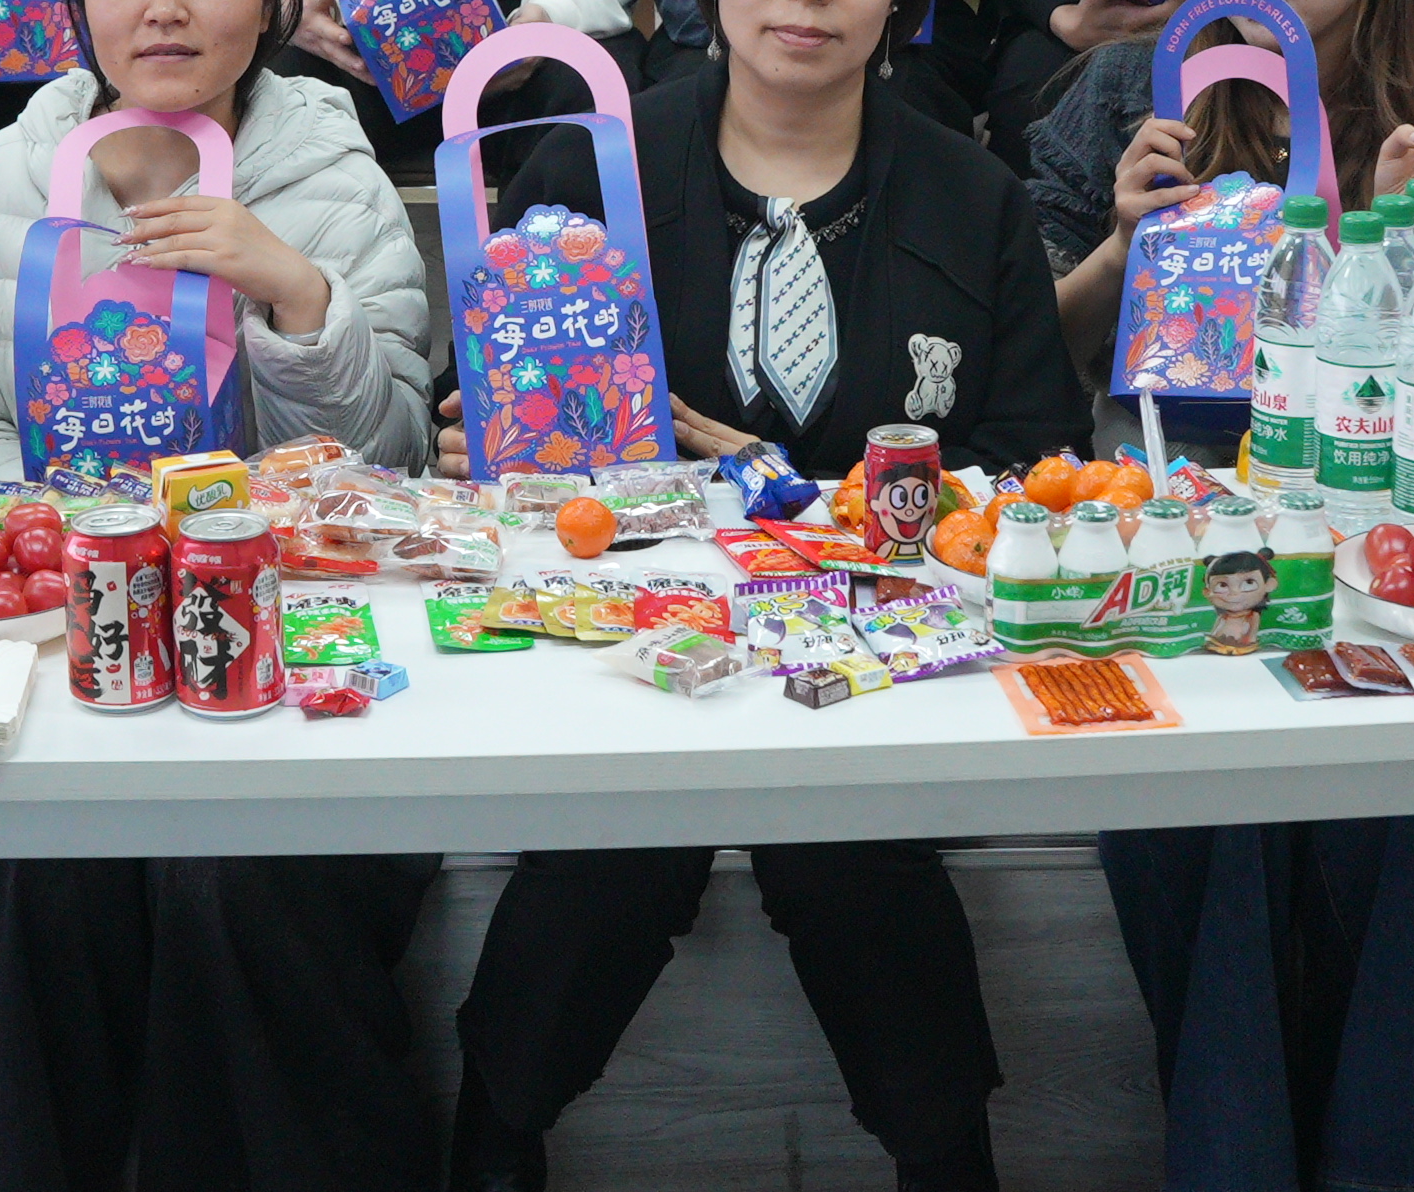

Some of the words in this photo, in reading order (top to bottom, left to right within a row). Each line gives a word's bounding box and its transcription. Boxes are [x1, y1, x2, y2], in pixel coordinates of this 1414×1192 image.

[1166, 19, 1190, 53] BORN
[491, 298, 620, 362] 每日花时
[1251, 386, 1289, 411] 夫山泉
[52, 398, 176, 452] 每日花时
[1333, 450, 1393, 467] 饮用纯净
[194, 487, 229, 505] 优酸乳
[1089, 563, 1193, 623] AD钙
